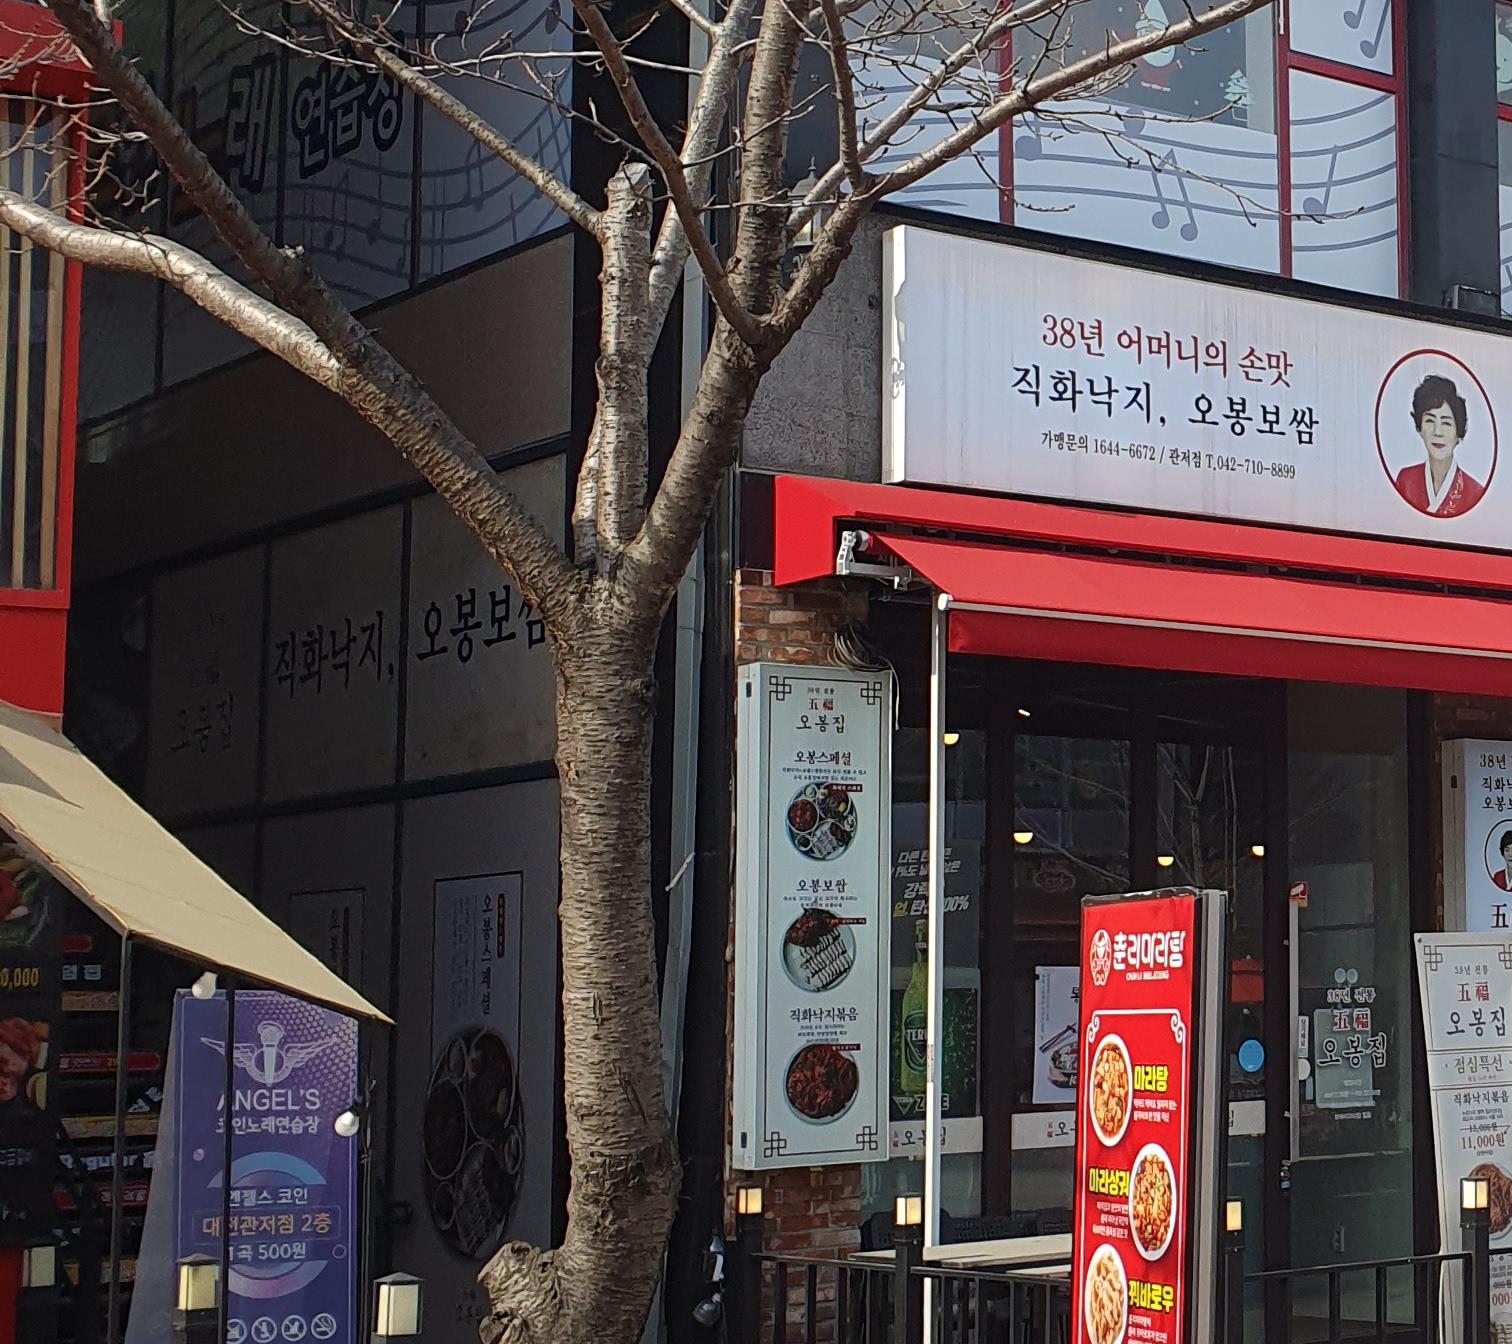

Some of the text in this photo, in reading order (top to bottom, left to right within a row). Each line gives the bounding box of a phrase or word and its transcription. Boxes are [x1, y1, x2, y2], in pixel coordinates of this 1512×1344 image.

[1042, 314, 1294, 388] 38년 어머니의 손맛
[1011, 364, 1320, 446] 직화낙지, 오봉보쌈
[1041, 430, 1089, 454] 가맹문의
[1093, 438, 1157, 462] 1644-6672
[796, 713, 846, 734] 오봉집
[1480, 754, 1507, 770] 38년
[796, 878, 848, 894] 오봉보쌈
[790, 1006, 860, 1024] 직화낙지볶음
[1446, 1006, 1506, 1037] 오봉집
[1316, 1032, 1387, 1068] 오봉집
[1133, 1064, 1169, 1093] 마라탕
[276, 1187, 308, 1205] 코인
[301, 1212, 332, 1233] 2층
[258, 1241, 307, 1260] 500원
